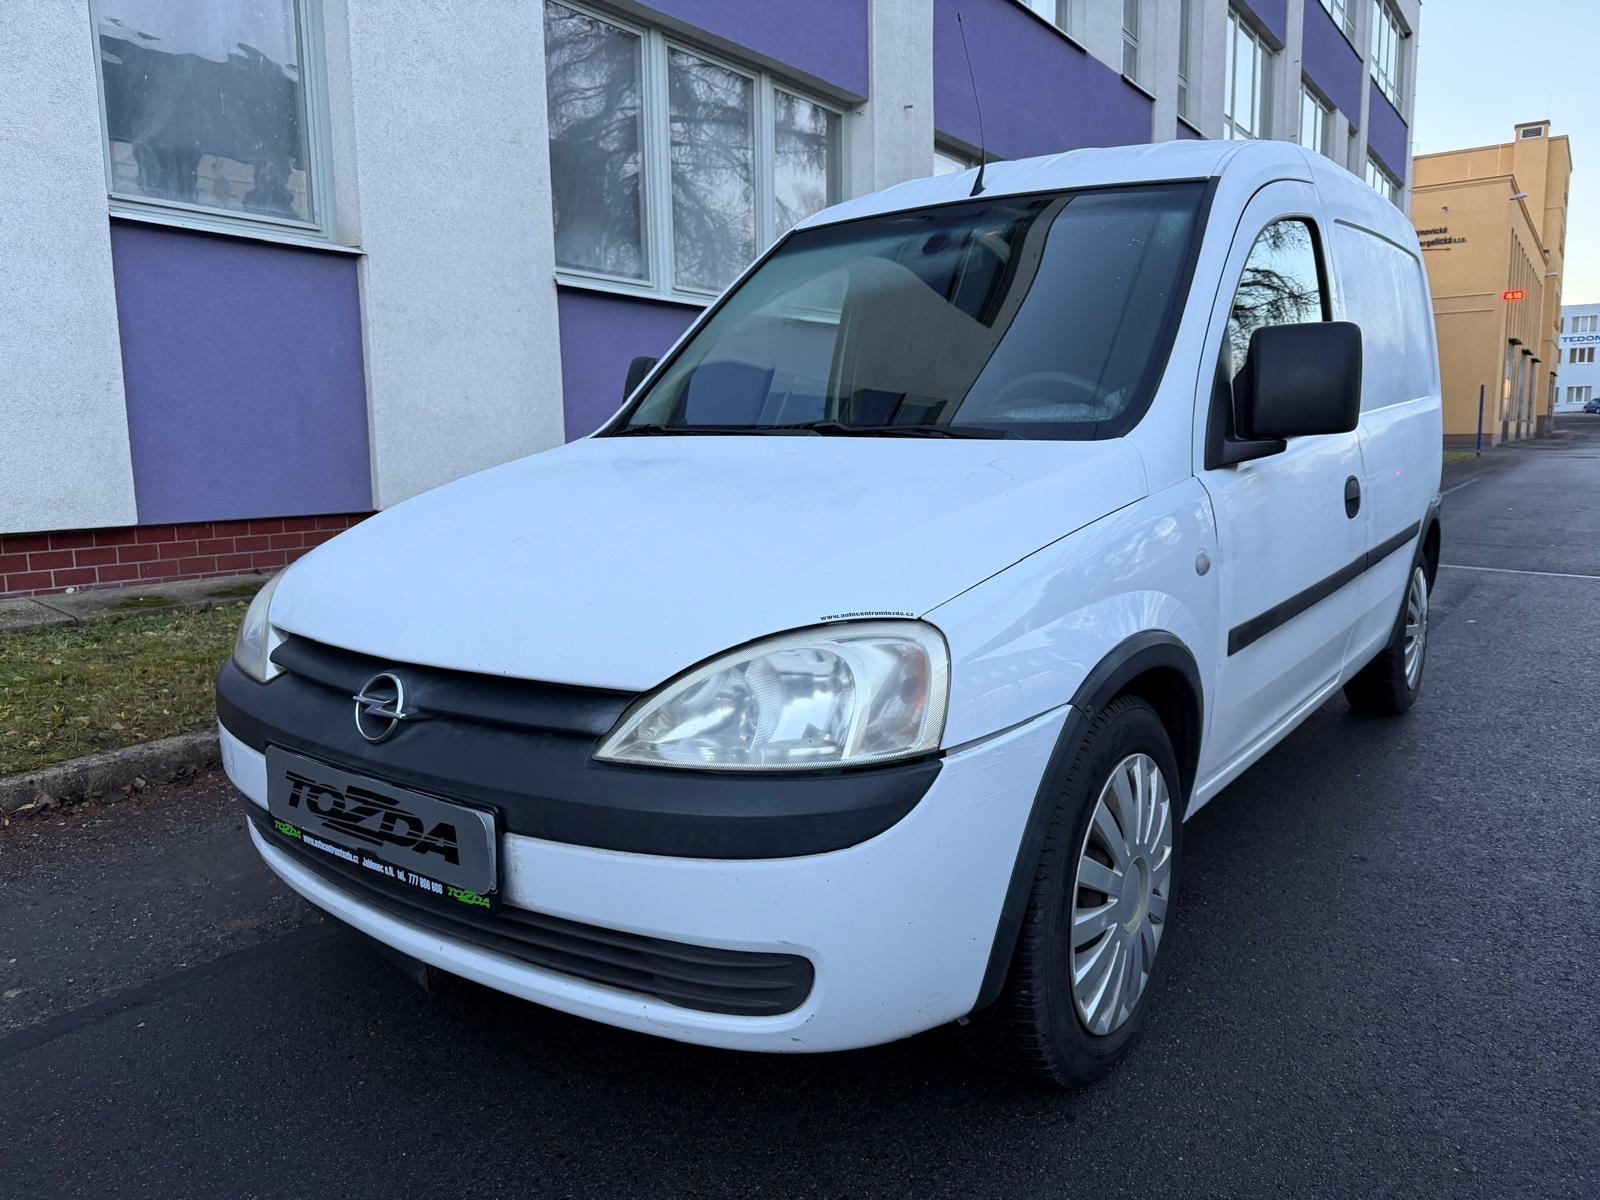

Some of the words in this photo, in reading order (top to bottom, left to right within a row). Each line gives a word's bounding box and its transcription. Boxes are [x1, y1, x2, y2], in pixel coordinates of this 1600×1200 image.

[285, 770, 460, 866] TOZDA
[274, 820, 301, 839] TOZDA
[408, 872, 419, 886] 777
[447, 886, 490, 908] TOZDA
